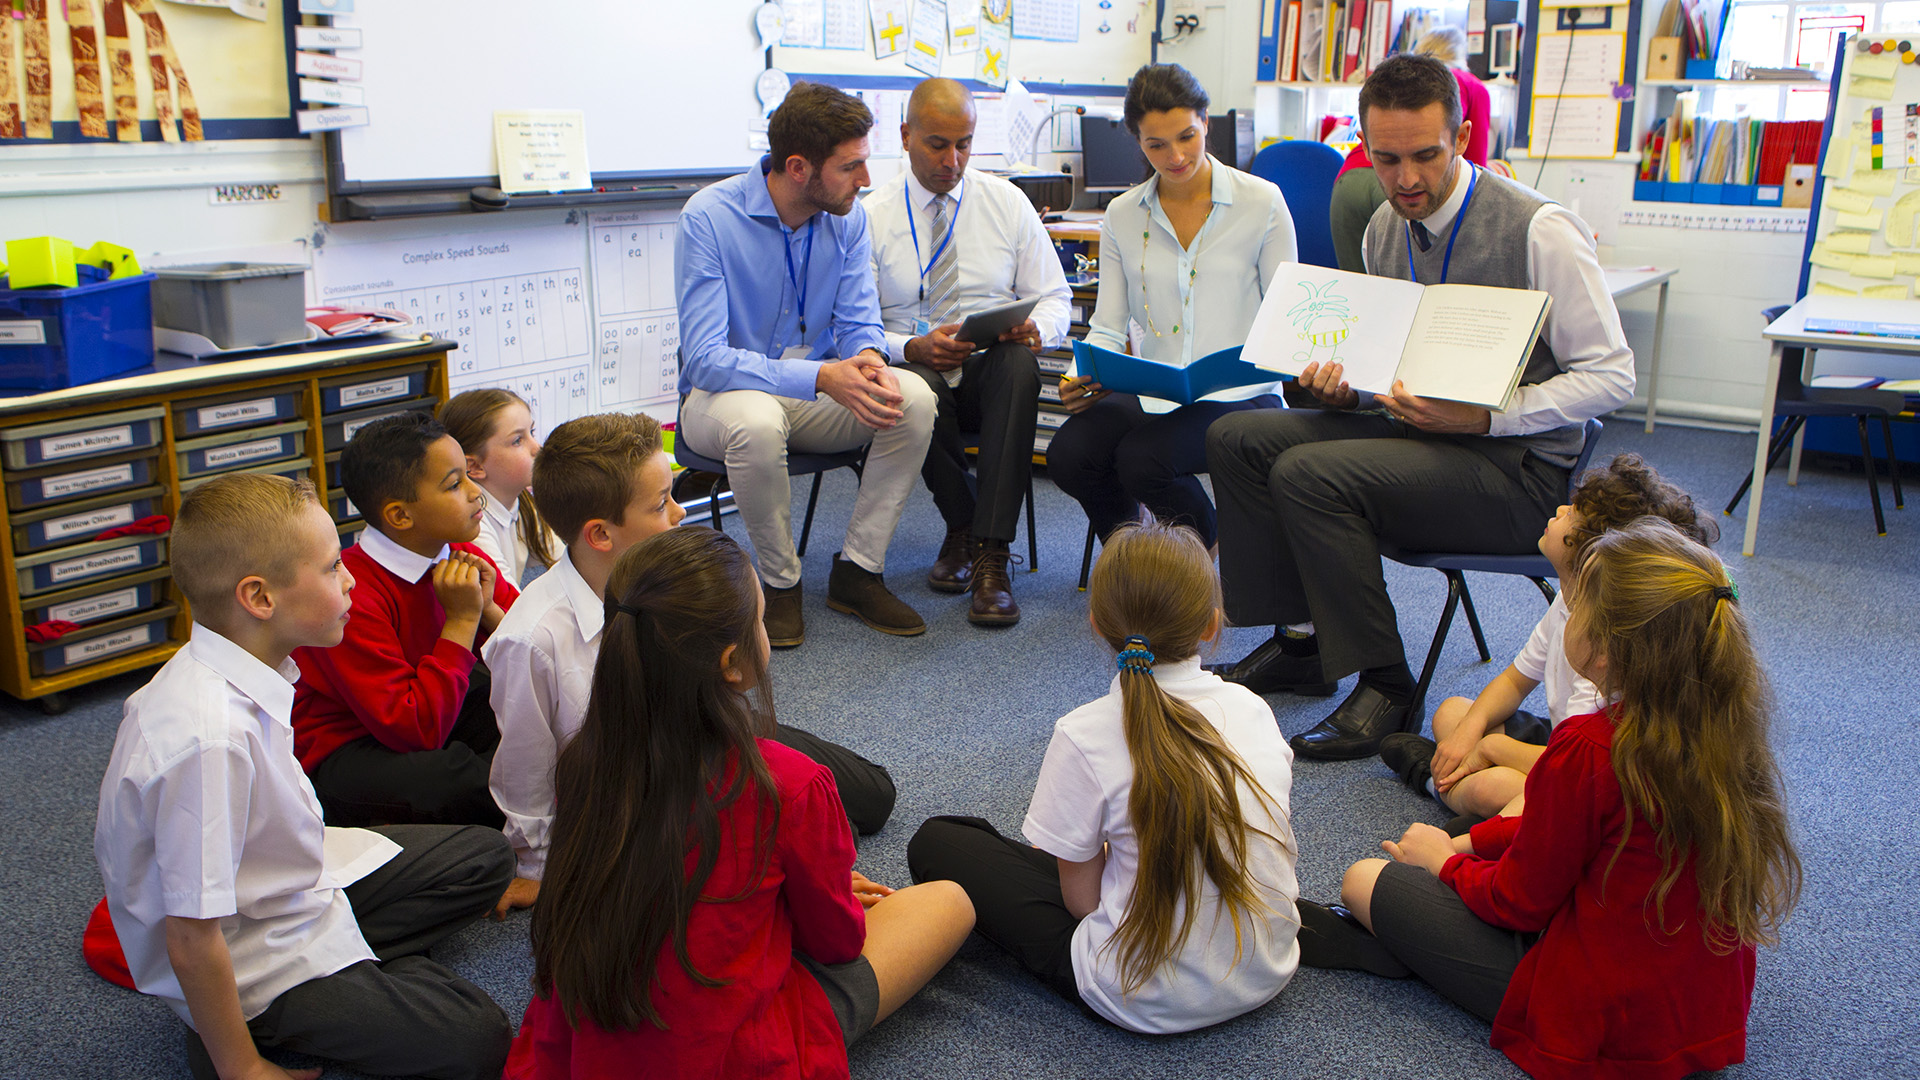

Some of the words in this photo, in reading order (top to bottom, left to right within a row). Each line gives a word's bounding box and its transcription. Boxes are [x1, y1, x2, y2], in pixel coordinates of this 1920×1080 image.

[318, 32, 342, 42] Noun
[312, 60, 348, 73] Adjective
[325, 88, 341, 97] Verb
[316, 114, 352, 125] Opinion
[216, 184, 281, 201] MARKING
[616, 213, 639, 221] sounds
[604, 234, 611, 243] a
[632, 232, 637, 241] e
[402, 250, 443, 264] Complex
[447, 246, 474, 260] Speed
[477, 242, 510, 256] Sounds
[628, 248, 642, 257] ea
[323, 282, 365, 294] Consonant
[367, 279, 394, 289] sounds
[384, 301, 395, 309] m
[411, 298, 418, 307] n
[436, 295, 440, 304] r
[460, 291, 464, 301] s
[481, 288, 487, 297] v
[504, 286, 509, 294] z
[522, 279, 534, 292] sh
[544, 277, 556, 289] th
[564, 277, 578, 289] ng
[435, 312, 445, 321] rr
[457, 308, 469, 319] ss
[480, 305, 492, 315] ve
[502, 302, 513, 312] zz
[525, 298, 534, 308] ti
[566, 291, 580, 303] nk
[458, 326, 471, 336] se
[506, 320, 512, 329] s
[526, 314, 536, 326] ci
[604, 329, 617, 339] oo
[625, 327, 639, 336] oo
[646, 325, 657, 334] ar
[665, 322, 675, 331] or
[463, 344, 468, 352] c
[504, 336, 516, 346] se
[662, 337, 678, 346] oor
[460, 360, 473, 371] ce
[603, 360, 616, 369] ue
[662, 352, 677, 362] ore
[523, 383, 532, 391] w
[544, 379, 549, 388] x
[560, 377, 565, 388] y
[573, 370, 584, 382] ch
[602, 376, 616, 385] ew
[662, 367, 676, 377] aw
[572, 385, 585, 398] tch
[662, 382, 674, 391] au
[215, 409, 239, 419] Daniel
[54, 441, 82, 451] James
[210, 452, 236, 462] Matilda
[237, 445, 277, 457] Williamson
[61, 519, 90, 530] Willow
[91, 514, 116, 524] Oliver
[56, 565, 85, 576] James
[68, 606, 97, 617] Callum
[98, 600, 119, 610] Shaw
[107, 635, 132, 646] Wood
